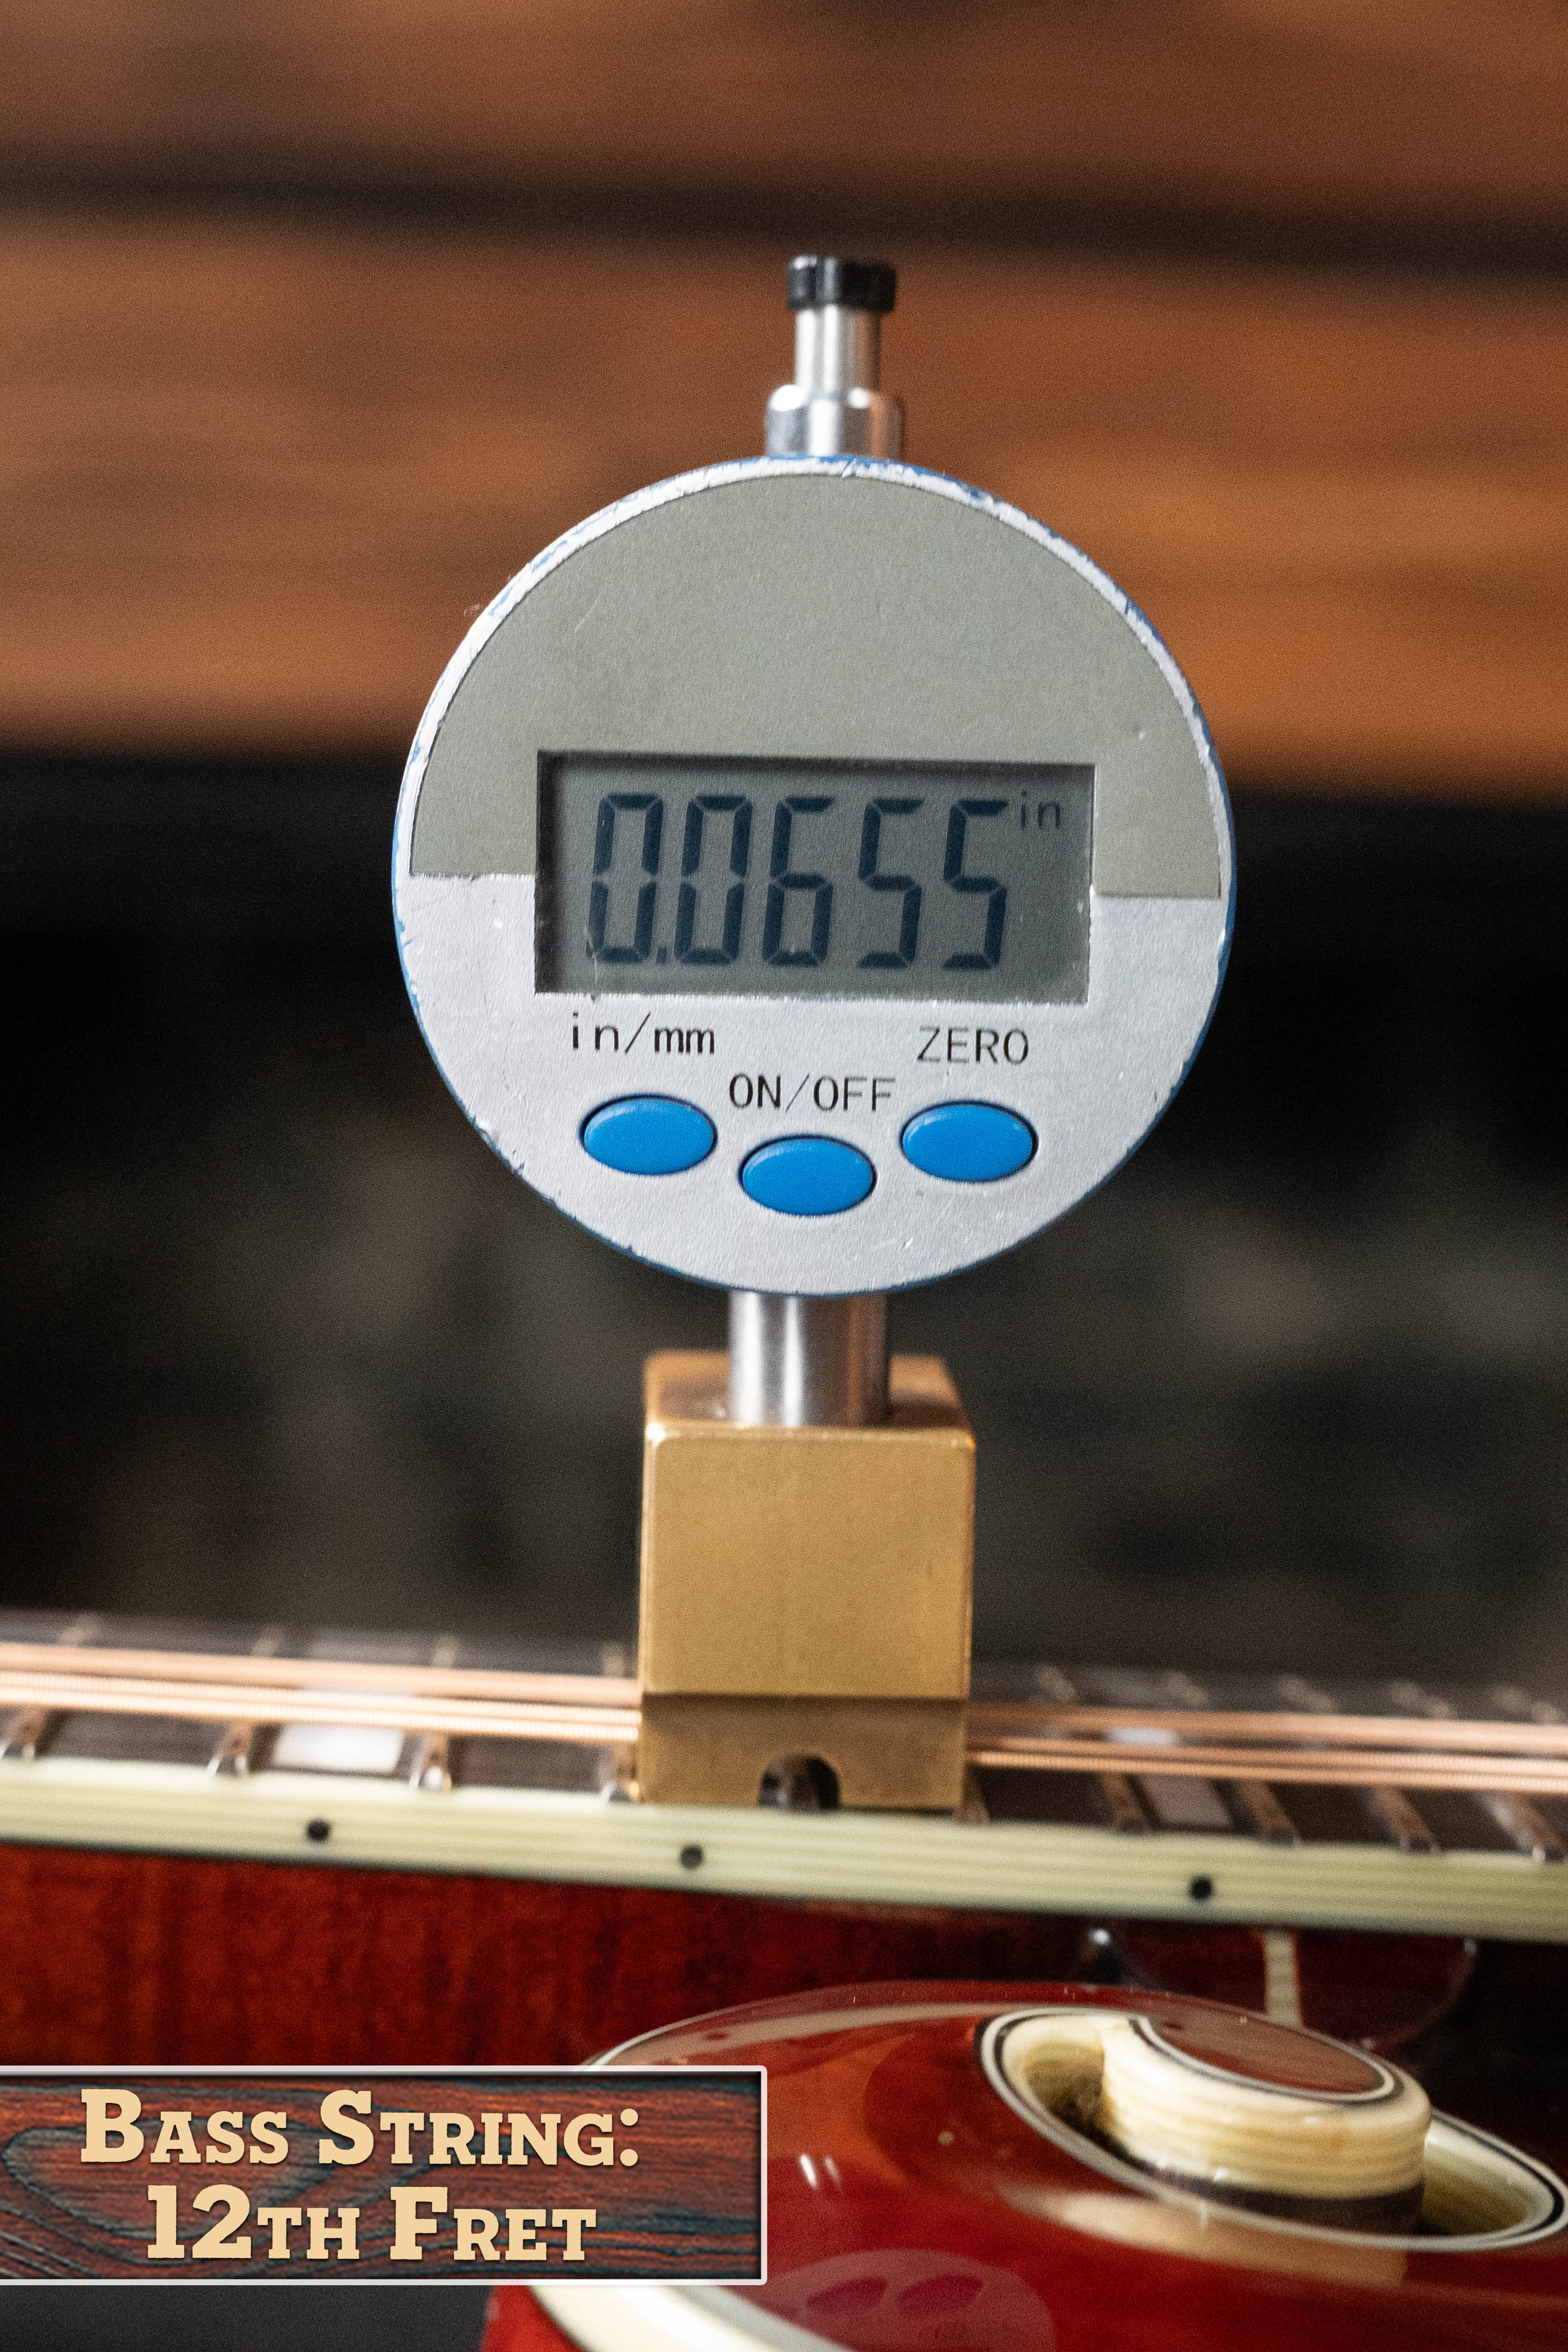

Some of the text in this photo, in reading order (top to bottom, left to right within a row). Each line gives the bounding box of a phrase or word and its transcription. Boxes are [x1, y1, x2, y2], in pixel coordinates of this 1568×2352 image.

[1019, 790, 1062, 830] in
[571, 1011, 716, 1055] in/mm
[916, 1026, 1030, 1065] ZERO
[728, 1073, 896, 1112] ON/OFF
